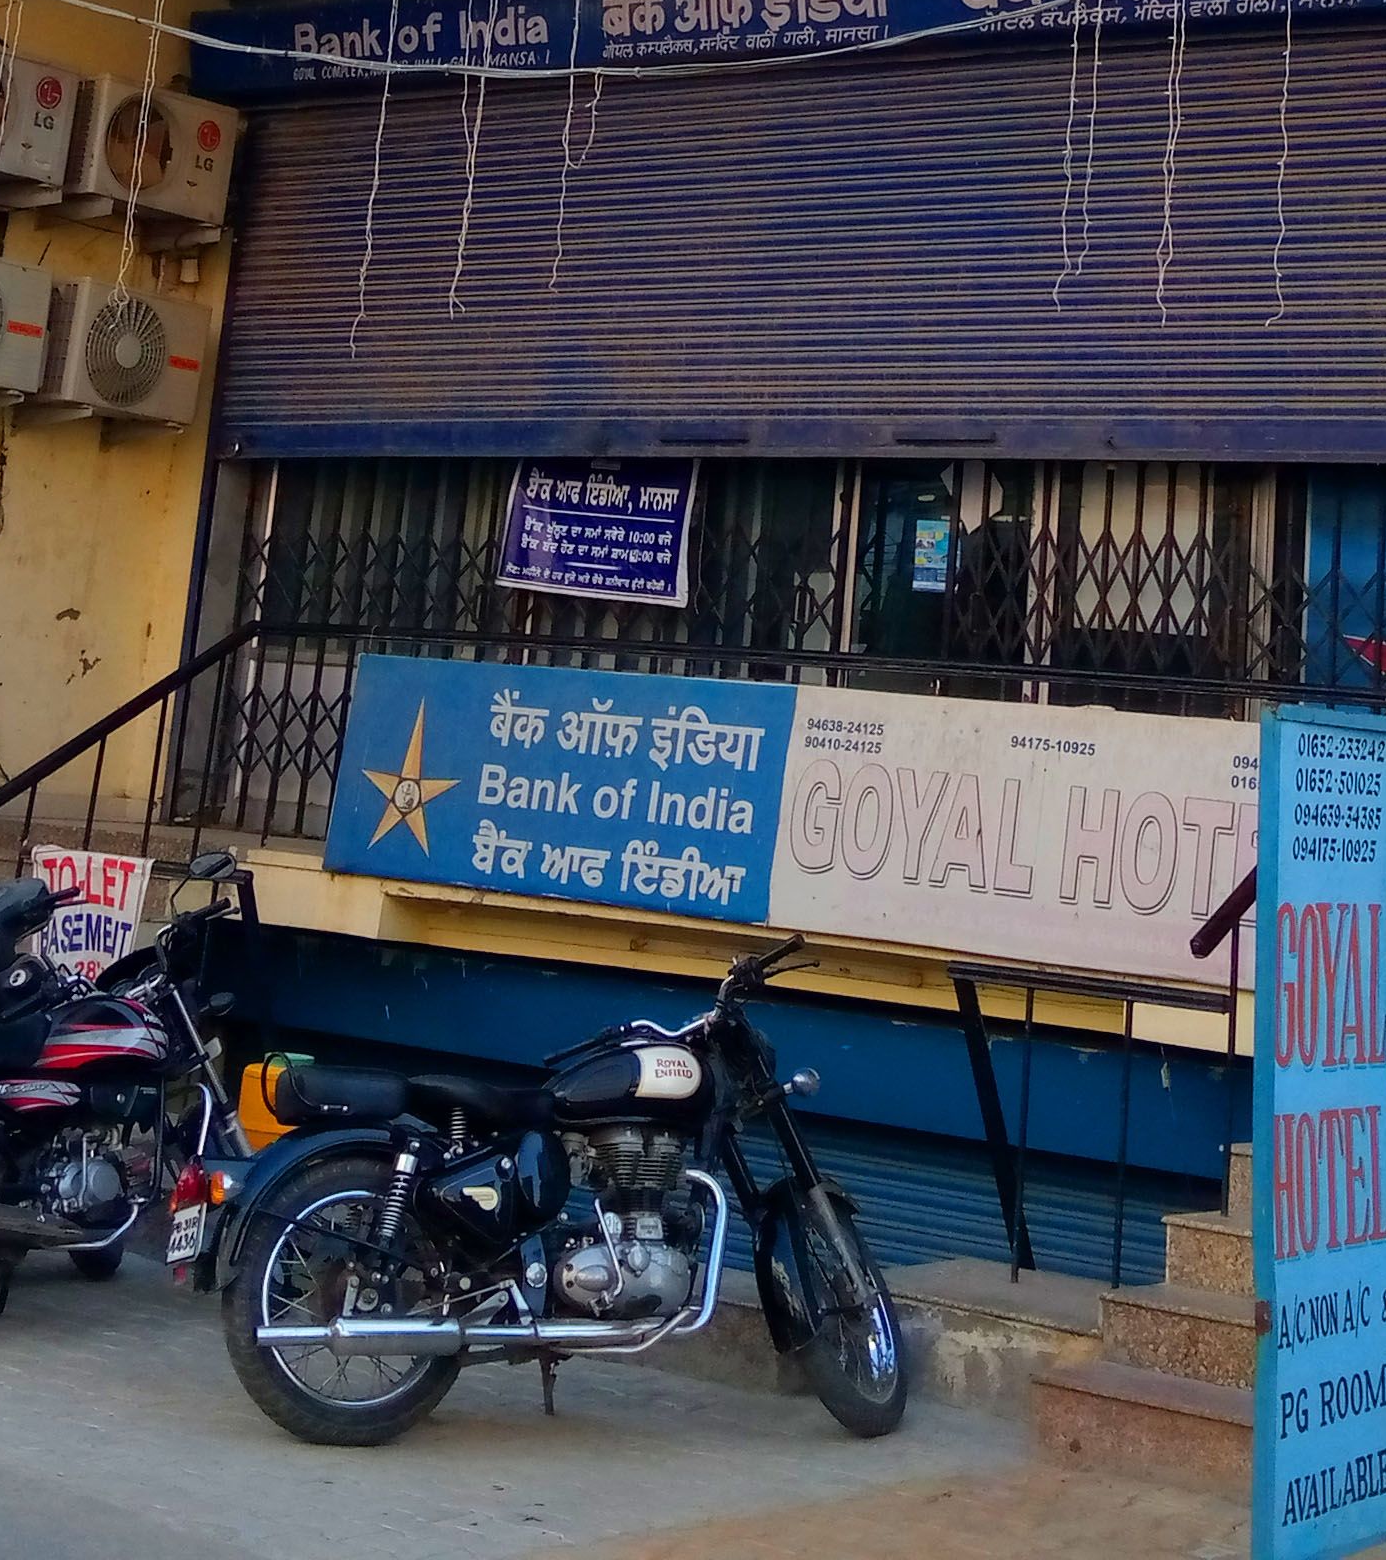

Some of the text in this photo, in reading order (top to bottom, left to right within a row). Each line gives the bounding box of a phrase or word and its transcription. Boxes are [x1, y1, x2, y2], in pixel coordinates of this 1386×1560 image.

[294, 4, 550, 63] Bank of India
[33, 111, 55, 131] LG
[194, 154, 215, 172] LG
[639, 485, 680, 513] ਮਾਨਸਾ
[628, 530, 656, 545] 10:00
[489, 687, 551, 750] बैंक
[649, 704, 766, 772] इंडिया
[803, 736, 883, 755] 90410-24125
[806, 717, 1096, 757] 94638-24125 94175-10925
[477, 763, 756, 835] Bank of India
[788, 757, 1036, 898] GOYAL
[41, 855, 137, 911] TO-LET
[470, 818, 748, 907] ਬੈਂਕ ਆਫ ਇੰਡੀਆ
[654, 1068, 694, 1079] ENFIELD
[655, 1058, 689, 1069] ROYAL
[1342, 1279, 1371, 1339] A/C
[1279, 1387, 1309, 1441] PG
